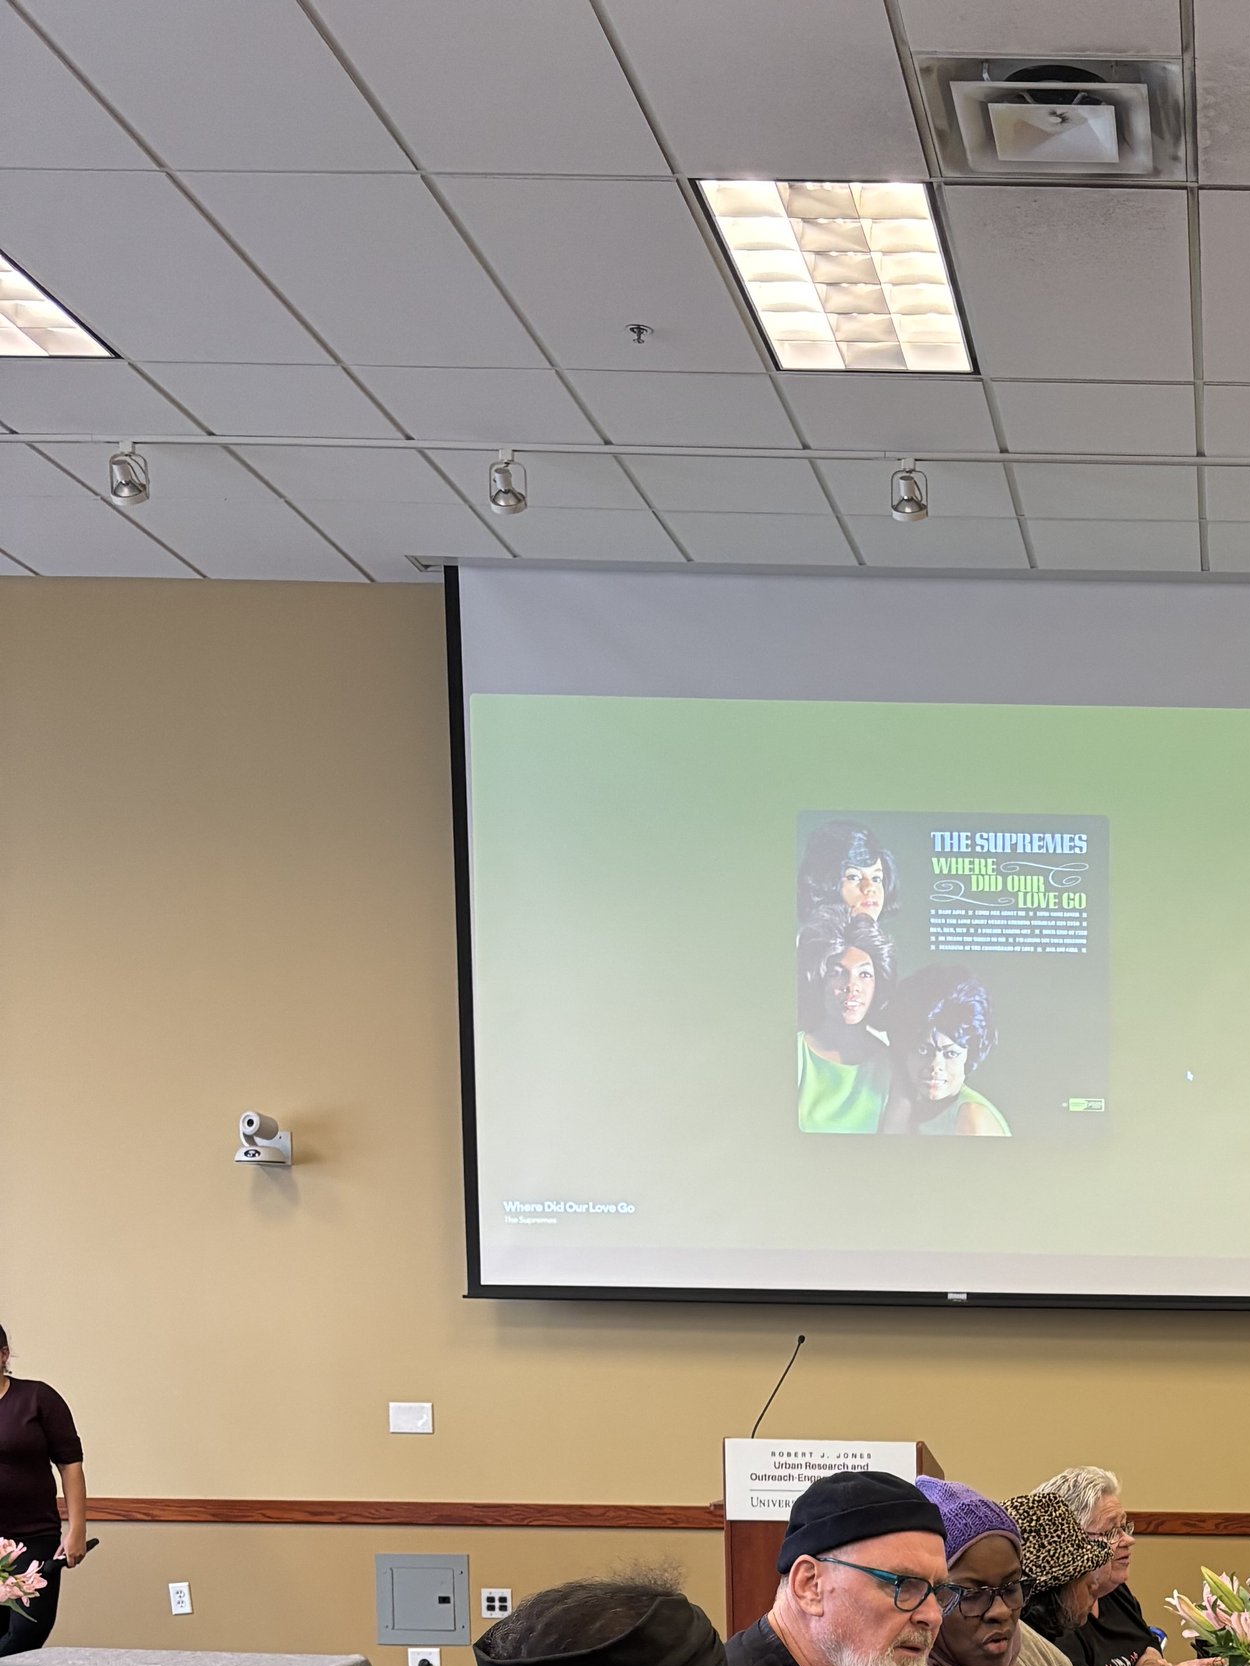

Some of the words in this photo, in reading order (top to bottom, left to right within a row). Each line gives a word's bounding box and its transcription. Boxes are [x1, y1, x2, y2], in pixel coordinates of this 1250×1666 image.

[931, 832, 971, 852] THE
[975, 832, 1088, 854] SUPREMES
[931, 857, 997, 875] WHERE
[971, 874, 1003, 892] DID
[1006, 875, 1046, 893] OUR
[1017, 891, 1059, 909] LOVE
[1062, 892, 1087, 910] GO
[503, 1201, 544, 1213] Where
[544, 1201, 565, 1213] Did
[566, 1202, 588, 1213] Our
[589, 1202, 617, 1213] Love
[617, 1202, 636, 1214] Go
[504, 1216, 518, 1224] The
[773, 1461, 803, 1471] Urban
[805, 1462, 849, 1471] Research
[850, 1462, 870, 1471] and
[749, 1472, 825, 1484] Outreach-Enga
